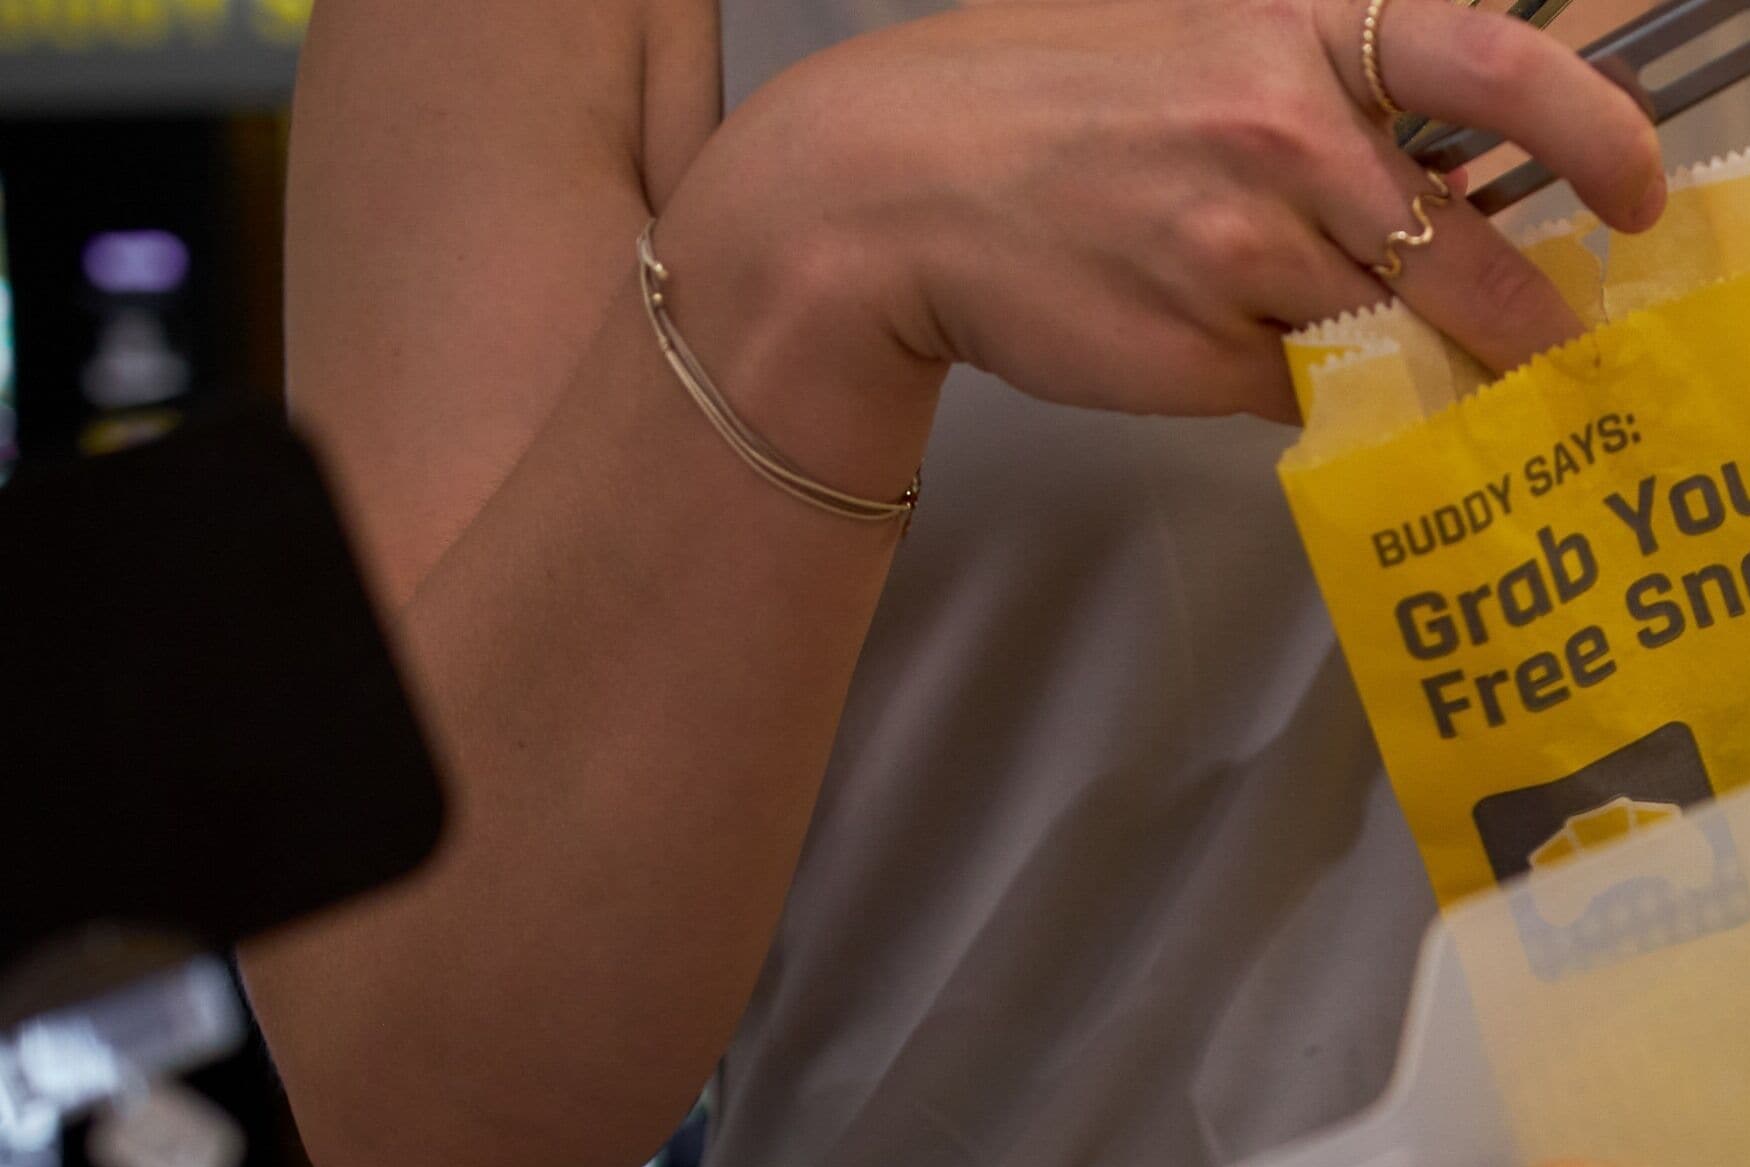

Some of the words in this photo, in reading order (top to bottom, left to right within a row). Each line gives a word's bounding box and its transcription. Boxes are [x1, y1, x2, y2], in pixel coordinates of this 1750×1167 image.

[1372, 473, 1514, 568] BUDDY
[1525, 413, 1642, 497] SAYS:
[1395, 525, 1597, 660] Grab
[1420, 626, 1617, 739] Free
